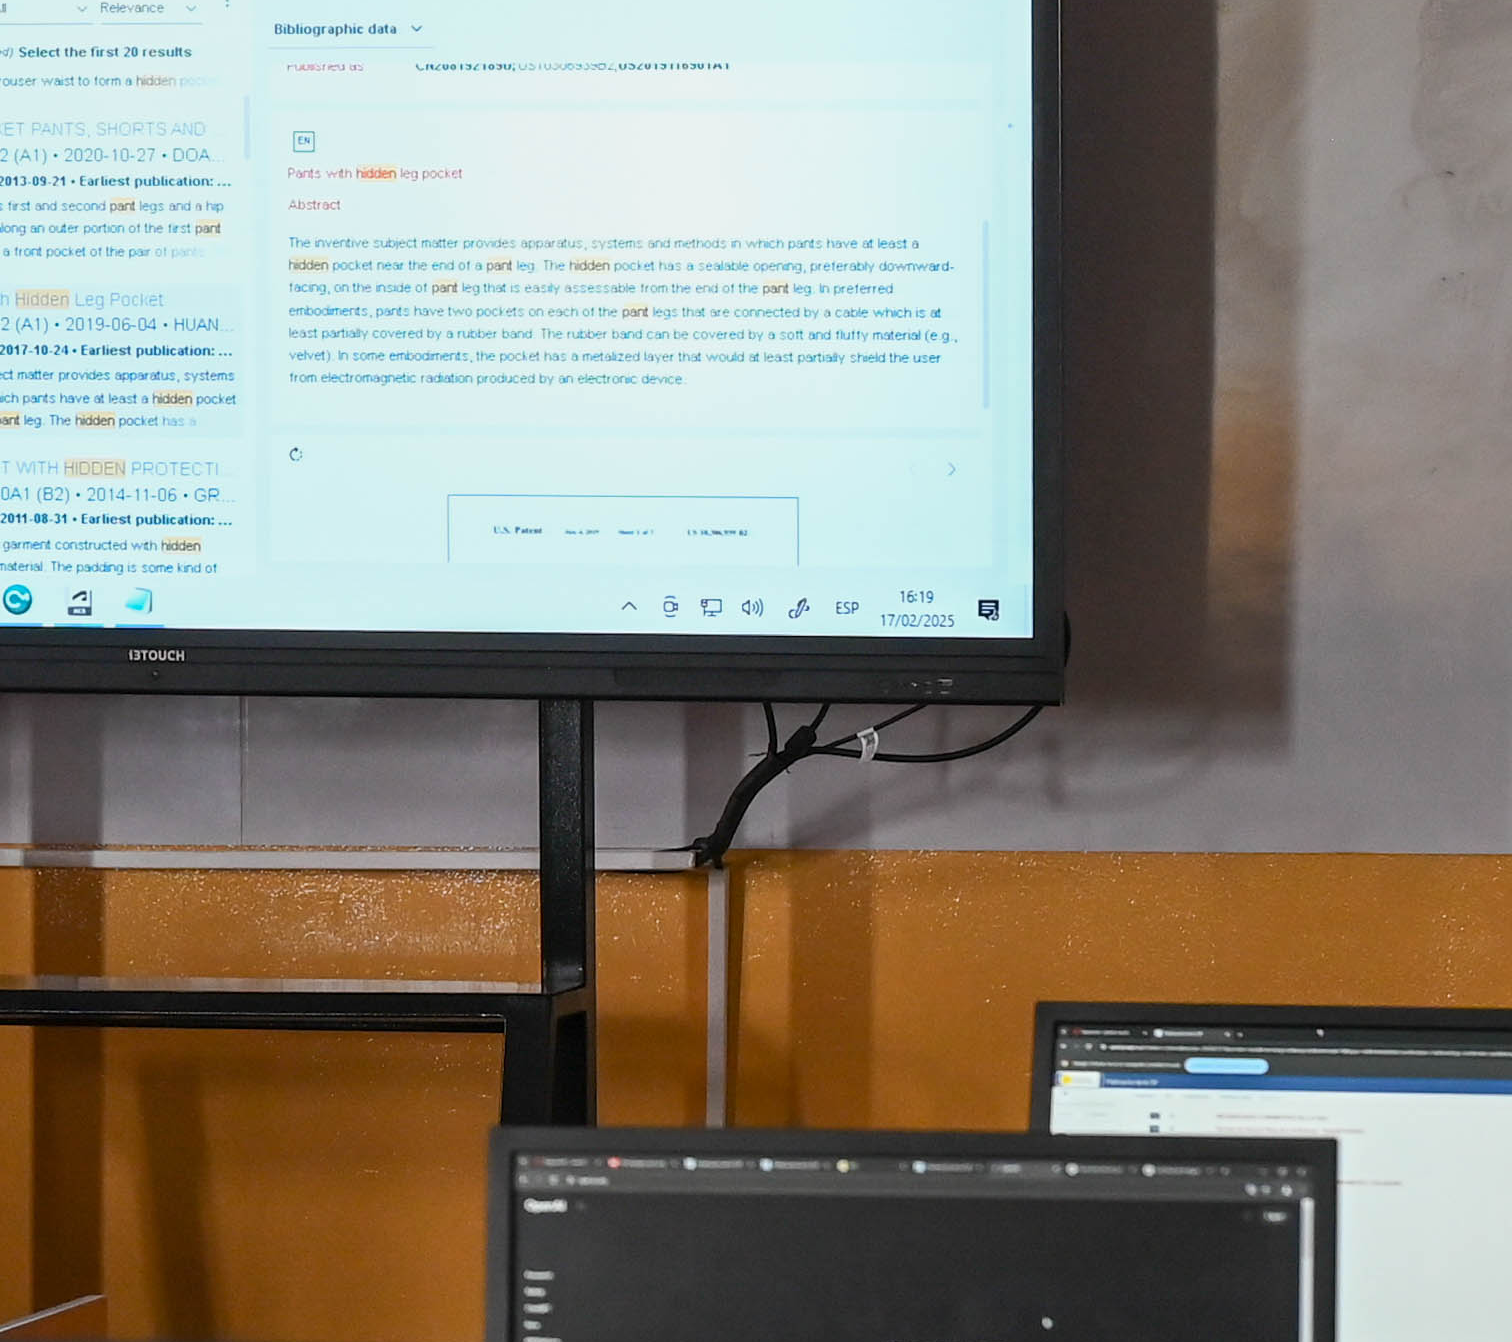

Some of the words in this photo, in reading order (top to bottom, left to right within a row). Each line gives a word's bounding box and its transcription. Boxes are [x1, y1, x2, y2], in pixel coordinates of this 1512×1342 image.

[100, 1, 165, 14] Relevance
[274, 23, 364, 38] Bibliographic
[368, 23, 397, 35] data
[19, 46, 60, 59] Select
[64, 46, 87, 58] the
[91, 46, 119, 58] first
[123, 46, 139, 58] 20
[142, 46, 192, 58] results
[96, 121, 168, 137] SHORTS
[171, 121, 206, 137] AND
[14, 148, 48, 166] (A1)
[64, 147, 156, 163] 2020-10-27
[288, 166, 322, 180] Pants
[326, 168, 353, 180] with
[357, 167, 397, 180] hidden
[400, 167, 418, 182] leg
[422, 168, 463, 182] pocket
[288, 199, 341, 211] Abstract
[16, 291, 69, 307] Hidden
[75, 292, 105, 311] Leg
[110, 292, 164, 308] Pocket
[15, 317, 49, 335] (A1)
[65, 316, 157, 332] 2019-06-04
[514, 526, 543, 535] Patent
[900, 589, 935, 604] 16:19
[835, 601, 860, 615] ESP
[880, 613, 955, 628] 17/02/2025
